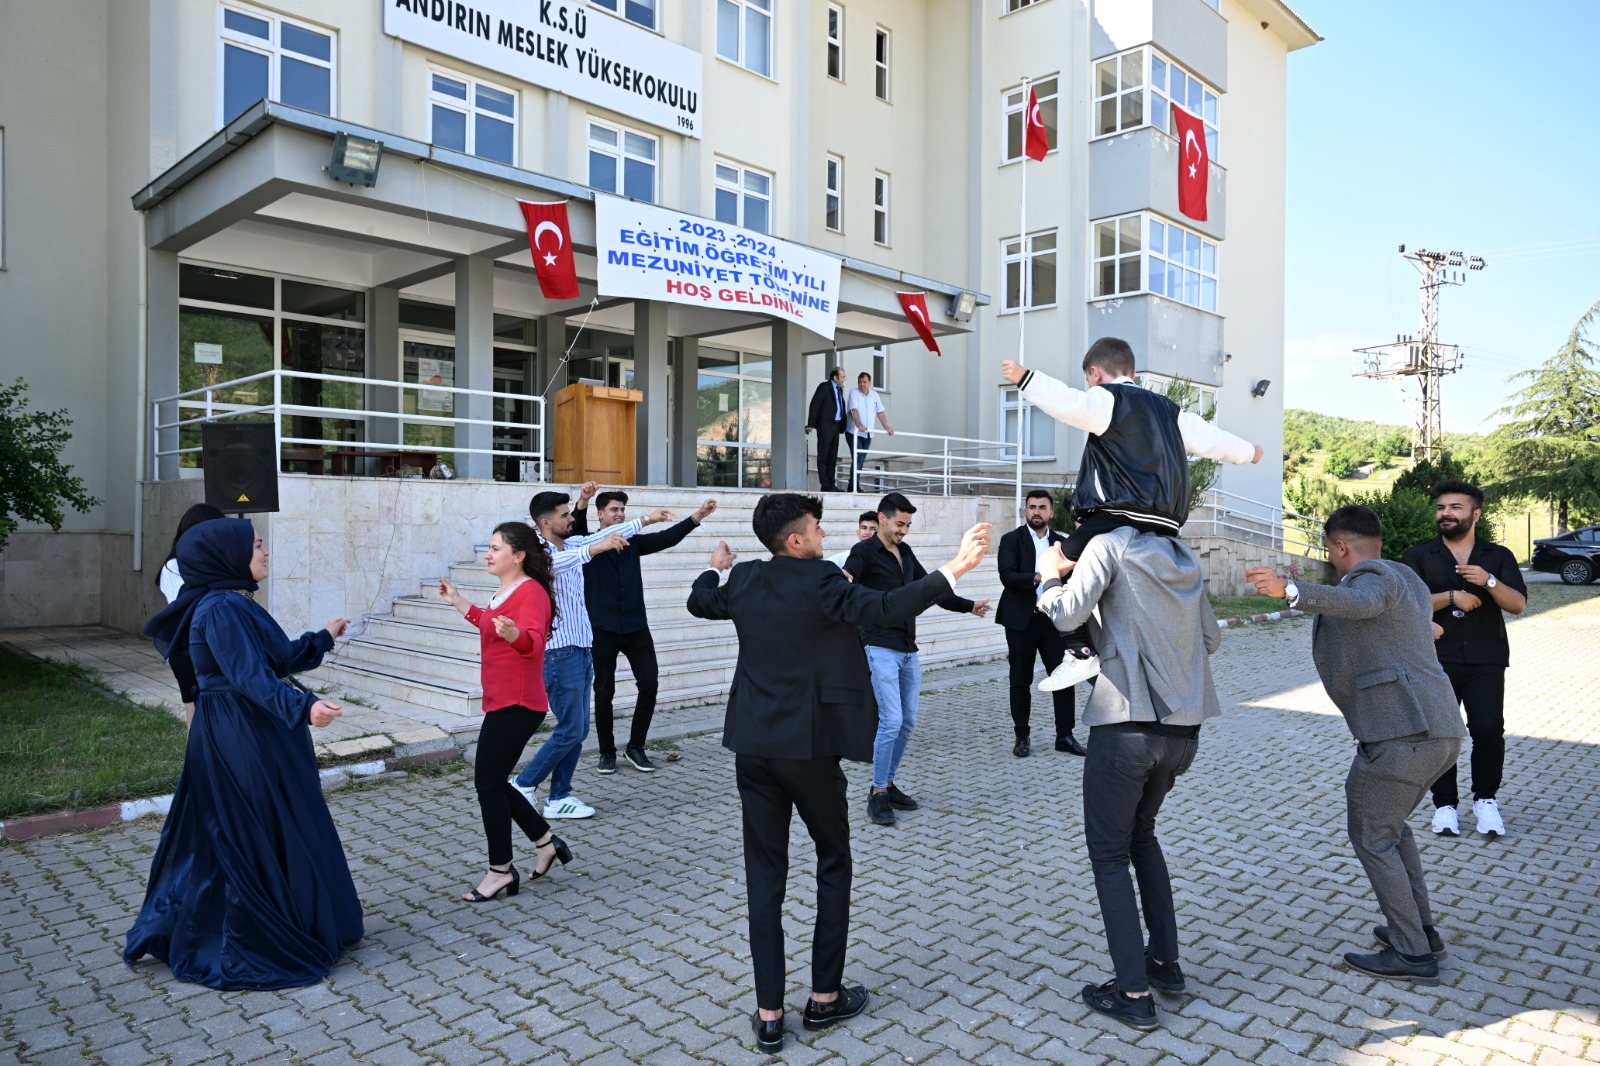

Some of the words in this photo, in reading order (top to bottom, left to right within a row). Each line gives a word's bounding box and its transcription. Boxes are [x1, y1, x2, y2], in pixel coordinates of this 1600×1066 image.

[539, 0, 587, 39] K.S.Ü
[497, 19, 569, 68] MESLEK
[575, 47, 697, 114] YÜKSEKOKULU
[677, 115, 694, 131] 1996
[679, 219, 726, 243] 2023
[620, 229, 700, 257] EĞİTİM
[791, 271, 826, 292] YILI
[607, 249, 743, 283] MEZUNİYET
[748, 273, 830, 313] TÖENİNE
[666, 279, 712, 302] HOŞ
